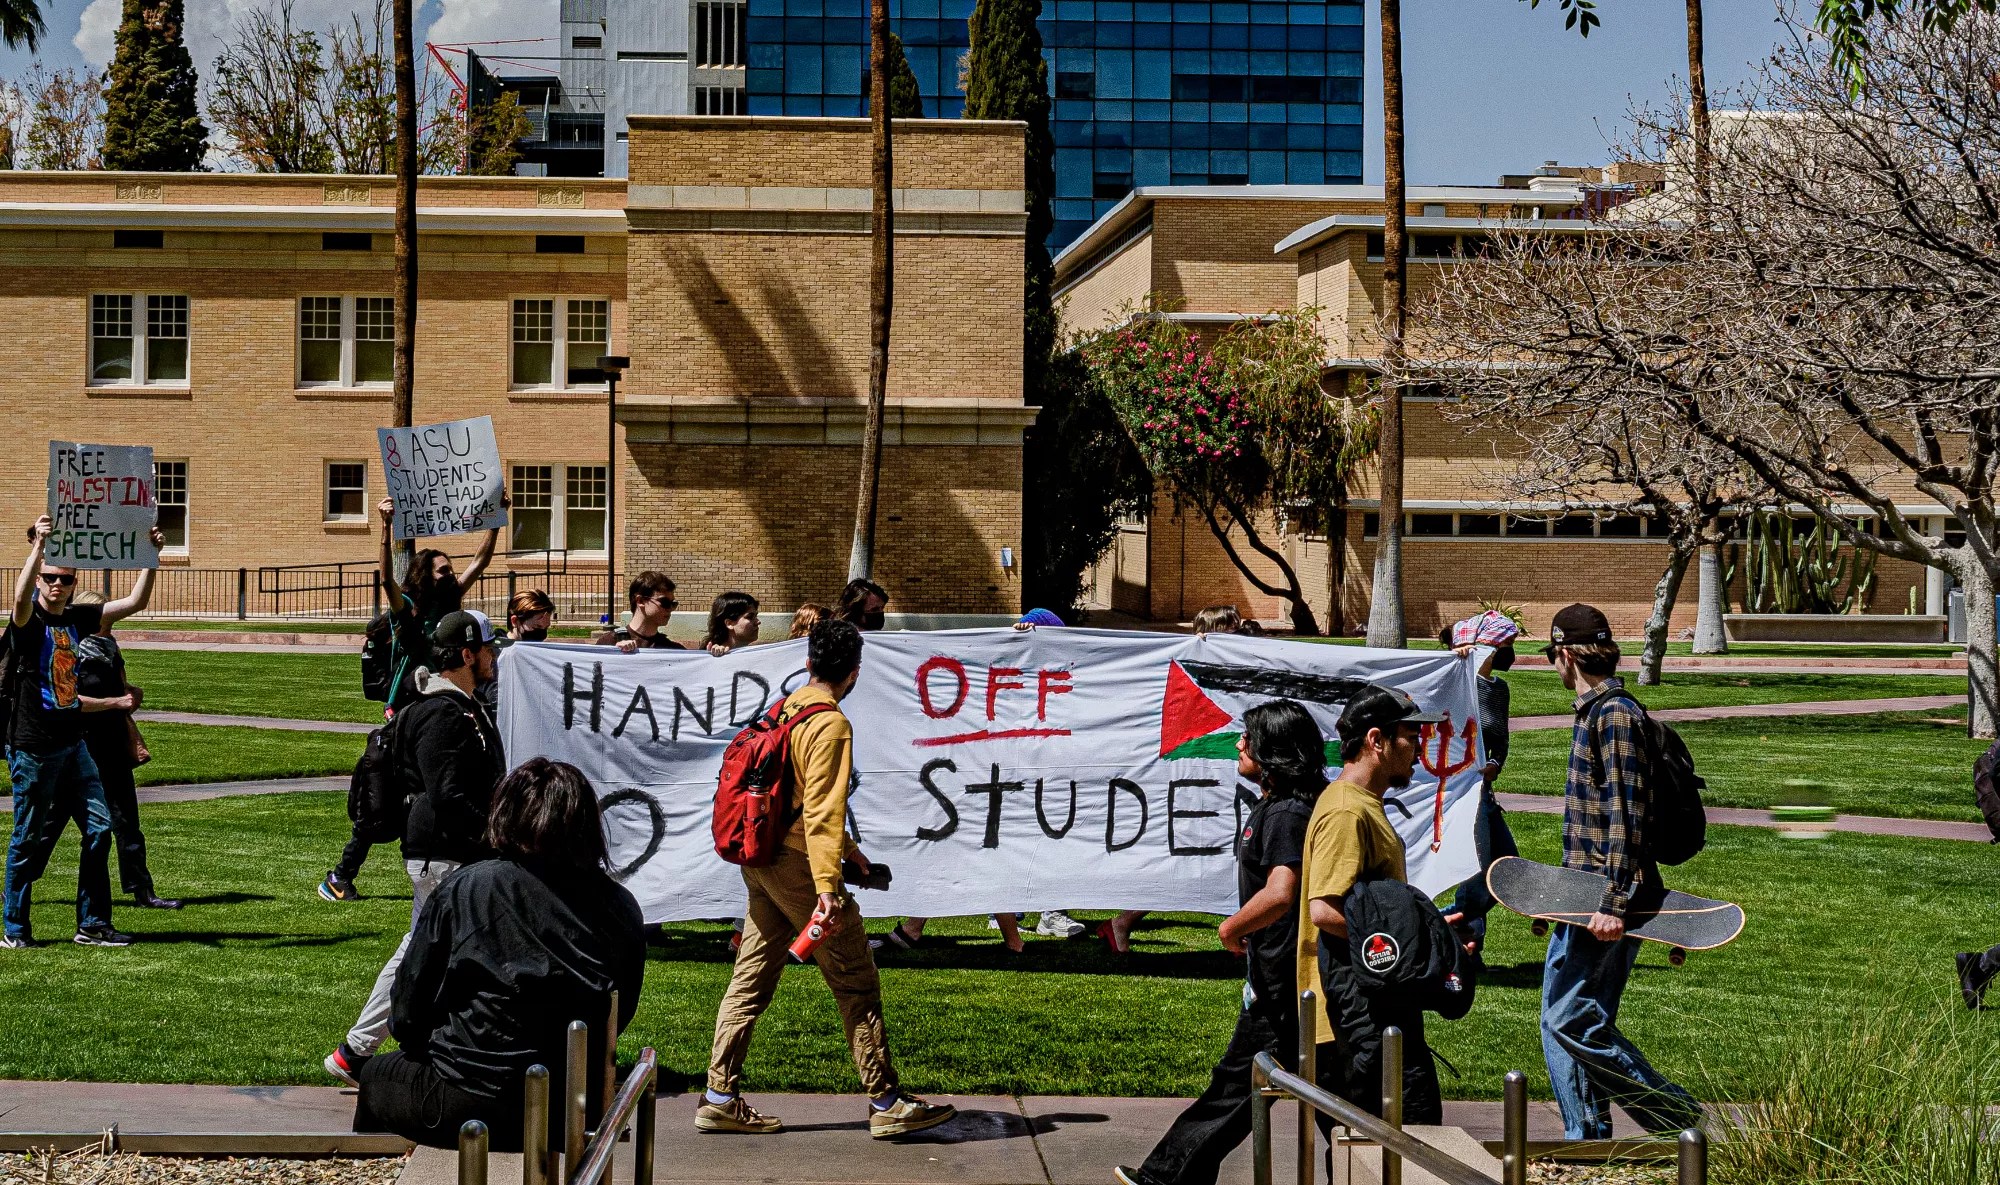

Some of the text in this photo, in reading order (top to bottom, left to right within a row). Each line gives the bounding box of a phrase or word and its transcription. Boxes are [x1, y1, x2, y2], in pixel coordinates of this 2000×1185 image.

[385, 426, 471, 468] 8 ASU
[57, 449, 106, 477] FREE
[389, 461, 487, 491] STUDENTS
[397, 485, 484, 510] HAVE HAD
[54, 503, 100, 530] FREE
[402, 499, 494, 526] THEIR VISAS
[404, 517, 484, 538] REVOKED
[50, 529, 137, 561] SPEECH
[914, 655, 1074, 722] OFF
[1368, 954, 1396, 967] CHICAGO
[1371, 950, 1391, 960] BULLS
